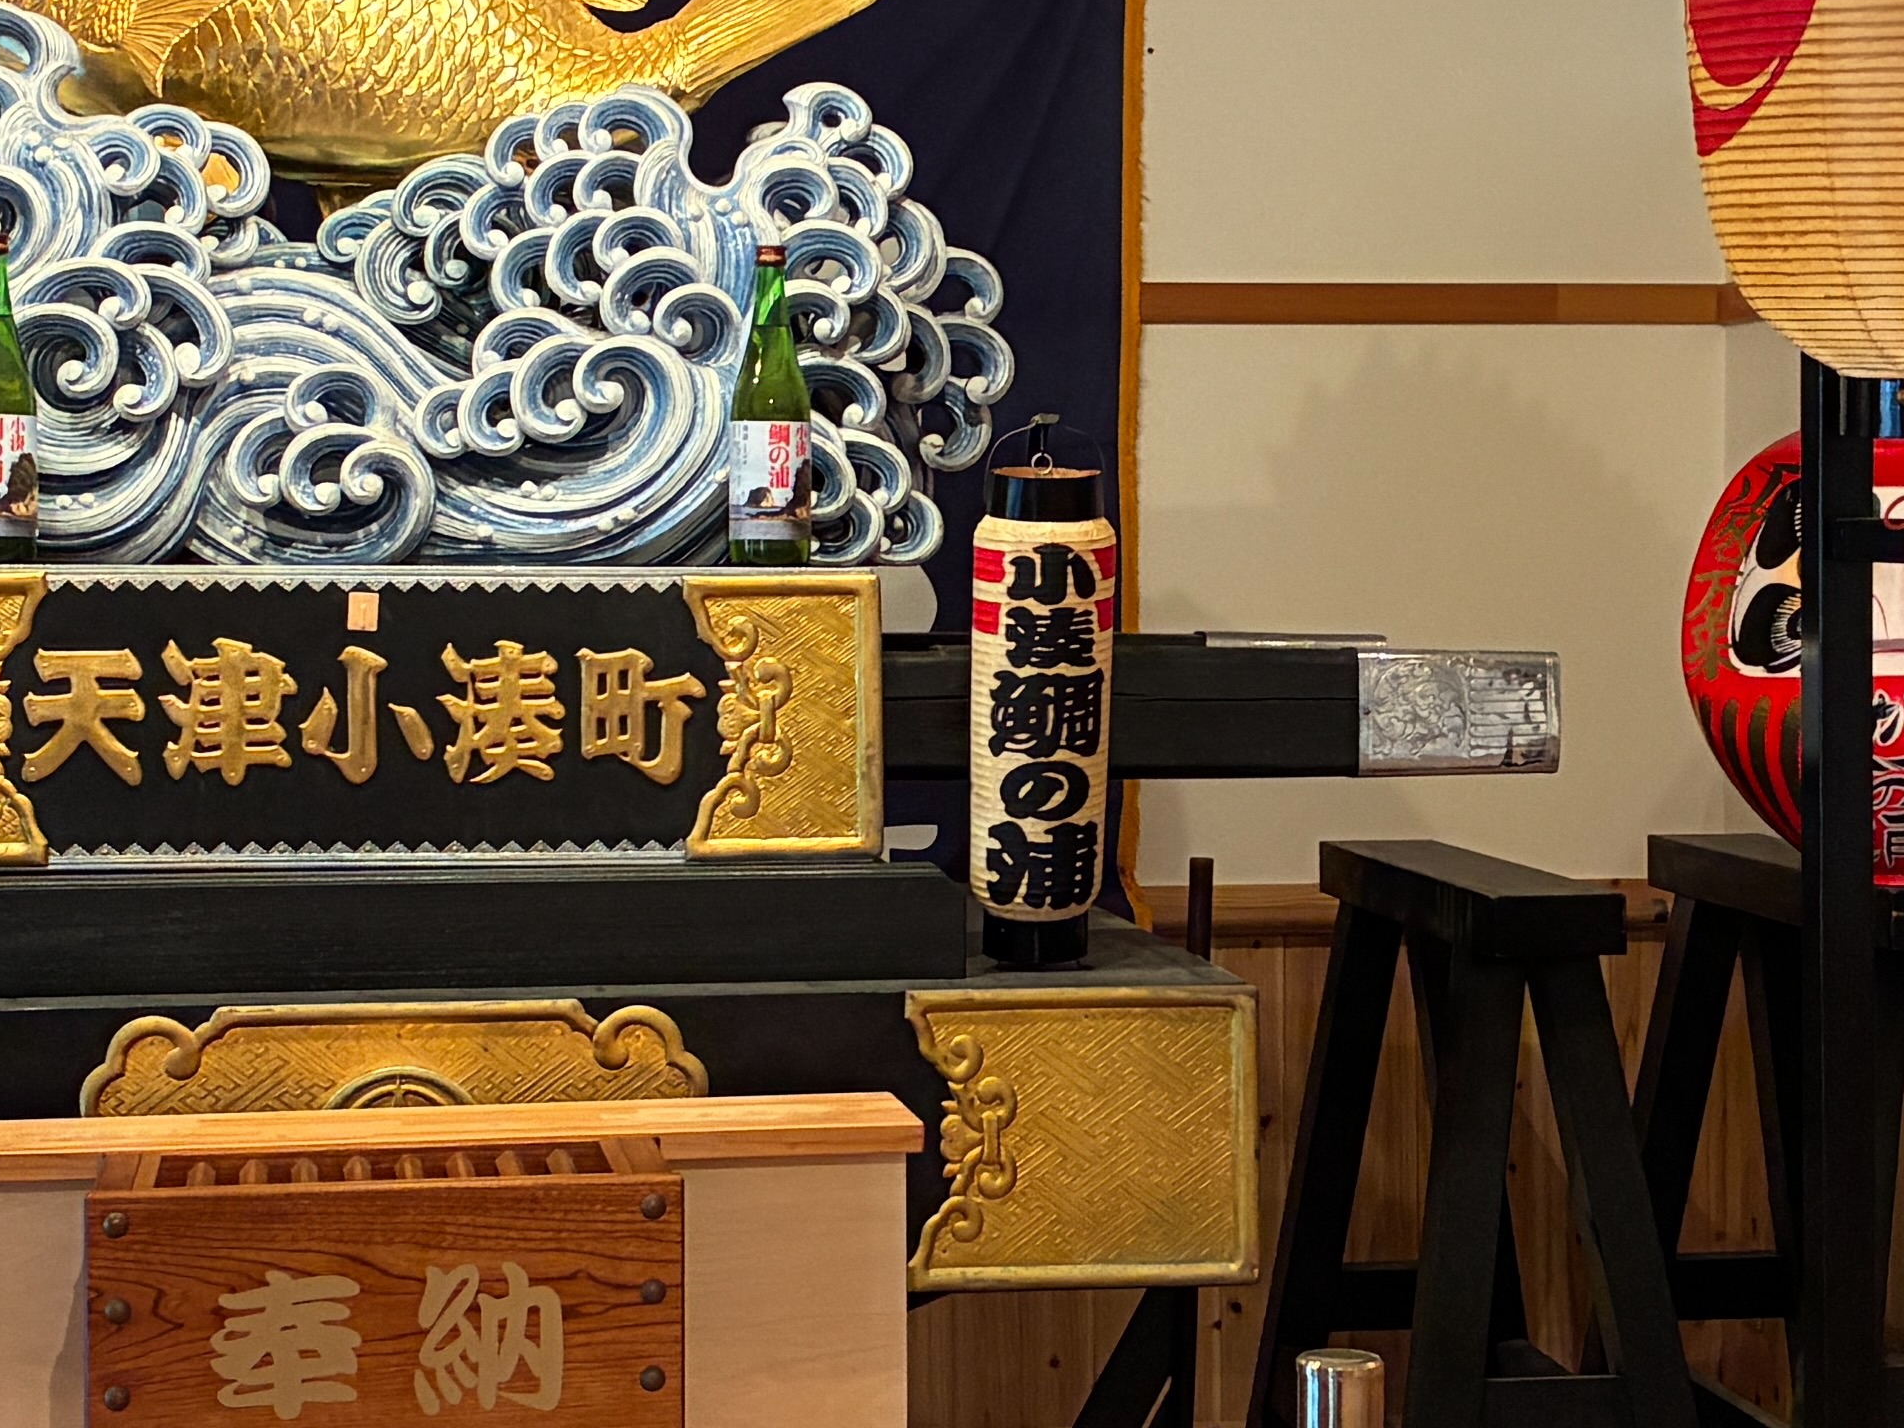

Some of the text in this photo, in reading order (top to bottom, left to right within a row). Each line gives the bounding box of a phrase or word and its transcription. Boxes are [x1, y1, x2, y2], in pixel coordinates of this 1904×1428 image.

[22, 638, 705, 786] 天津小湊町
[986, 543, 1103, 910] 小湊鯛の浦
[210, 1262, 564, 1420] 奉納
